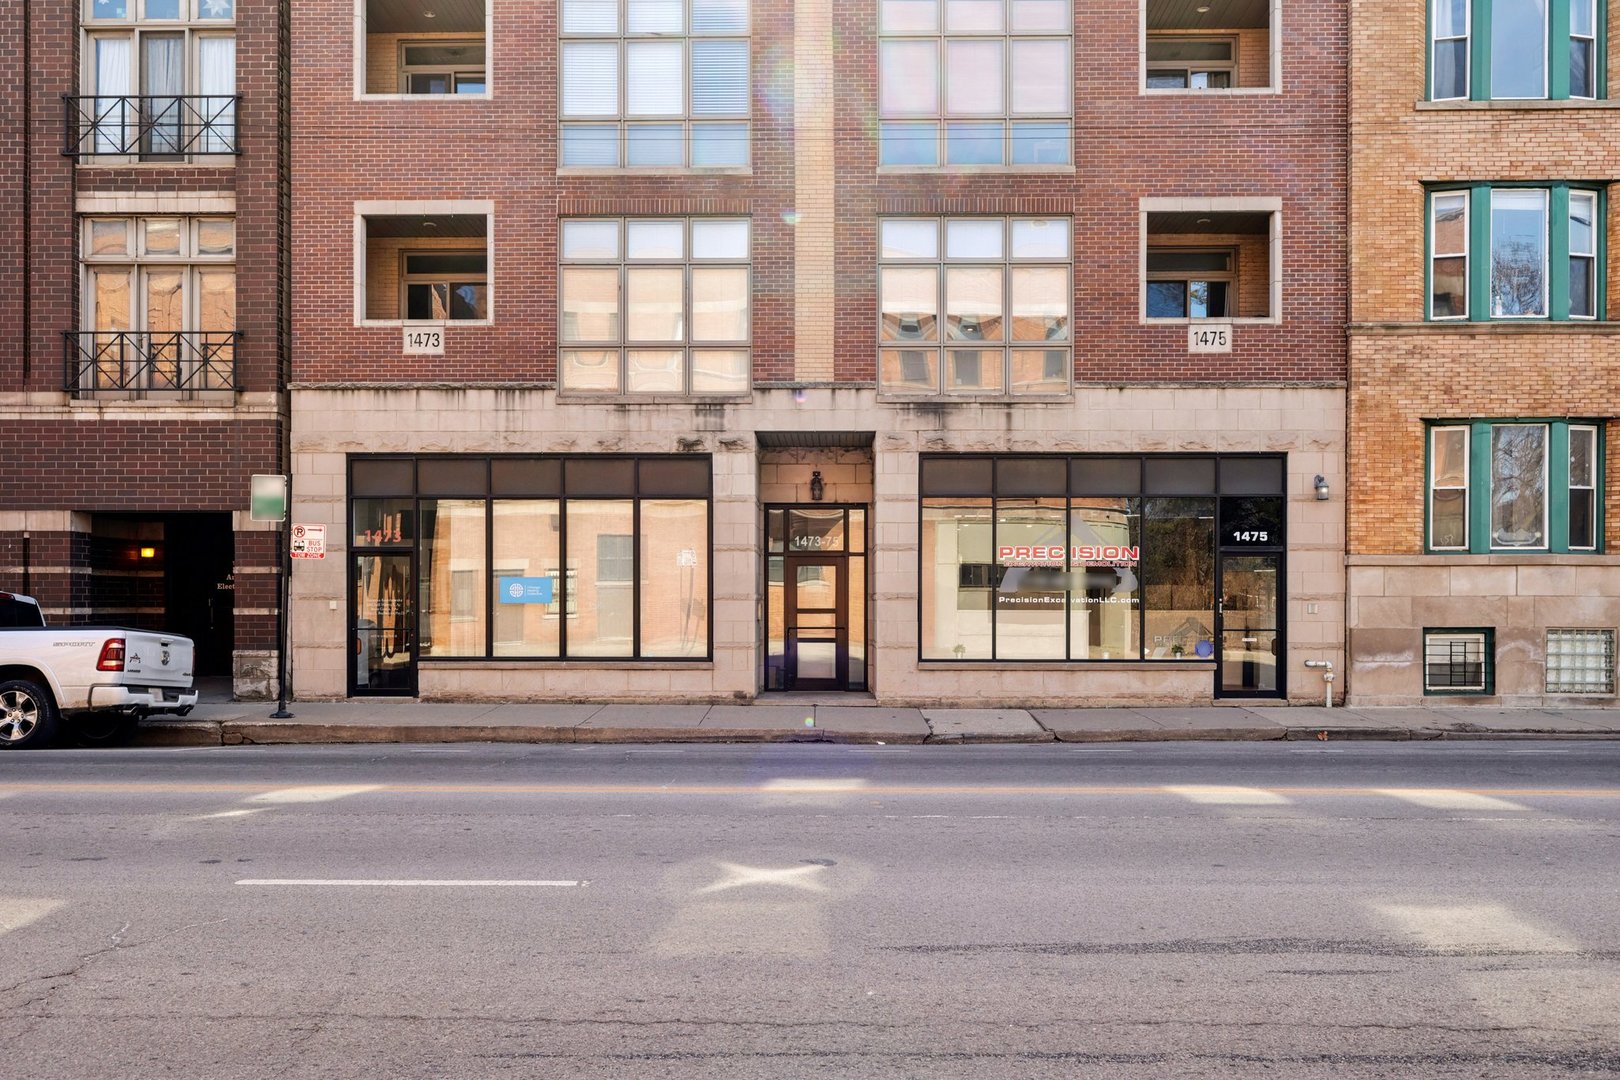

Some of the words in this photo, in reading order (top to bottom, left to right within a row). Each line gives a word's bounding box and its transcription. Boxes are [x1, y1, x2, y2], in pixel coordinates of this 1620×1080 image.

[407, 332, 440, 348] 1473
[1194, 331, 1227, 346] 1475
[364, 529, 402, 543] 1473
[794, 536, 839, 547] 1473-75
[1233, 531, 1268, 541] 1475
[998, 545, 1140, 560] PRECISION
